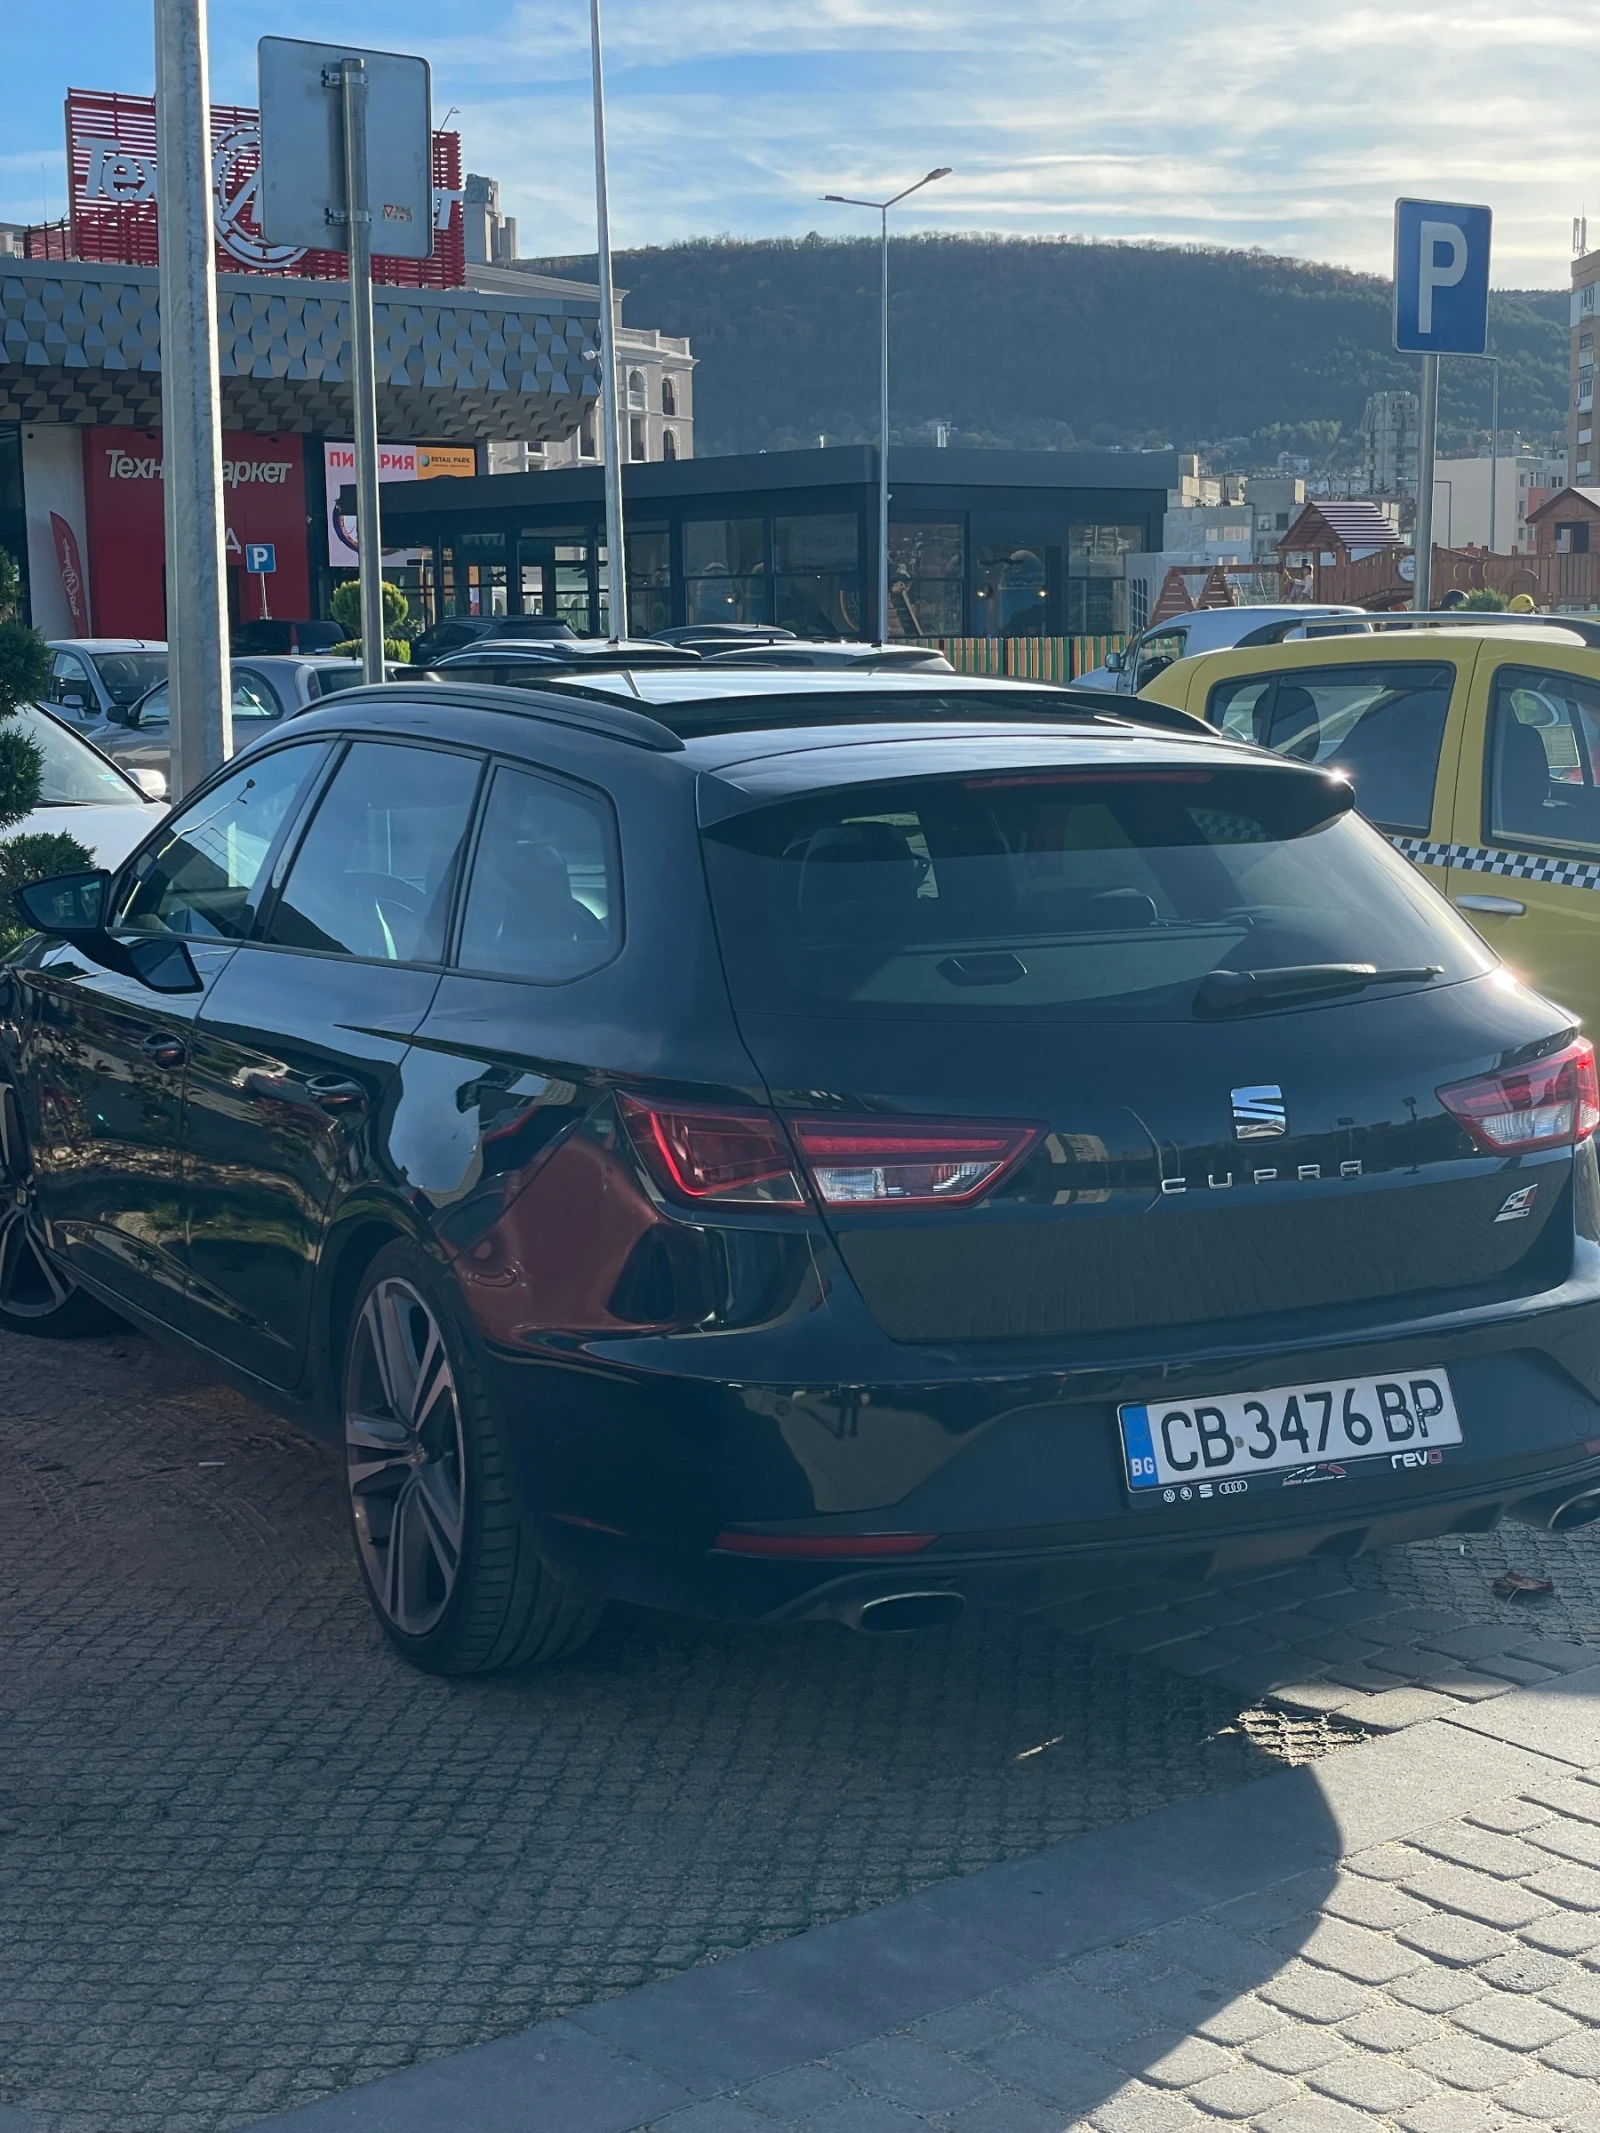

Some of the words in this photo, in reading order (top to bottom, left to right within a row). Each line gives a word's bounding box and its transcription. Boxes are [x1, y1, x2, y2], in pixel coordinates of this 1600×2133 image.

[1418, 220, 1468, 334] P
[105, 449, 293, 489] Технаркет
[329, 451, 415, 470] ПИРИЯ
[252, 547, 269, 570] P
[1161, 1160, 1363, 1195] CUPRA
[1243, 1388, 1372, 1460] 3476
[1375, 1379, 1444, 1443] BP
[1131, 1456, 1155, 1477] BG
